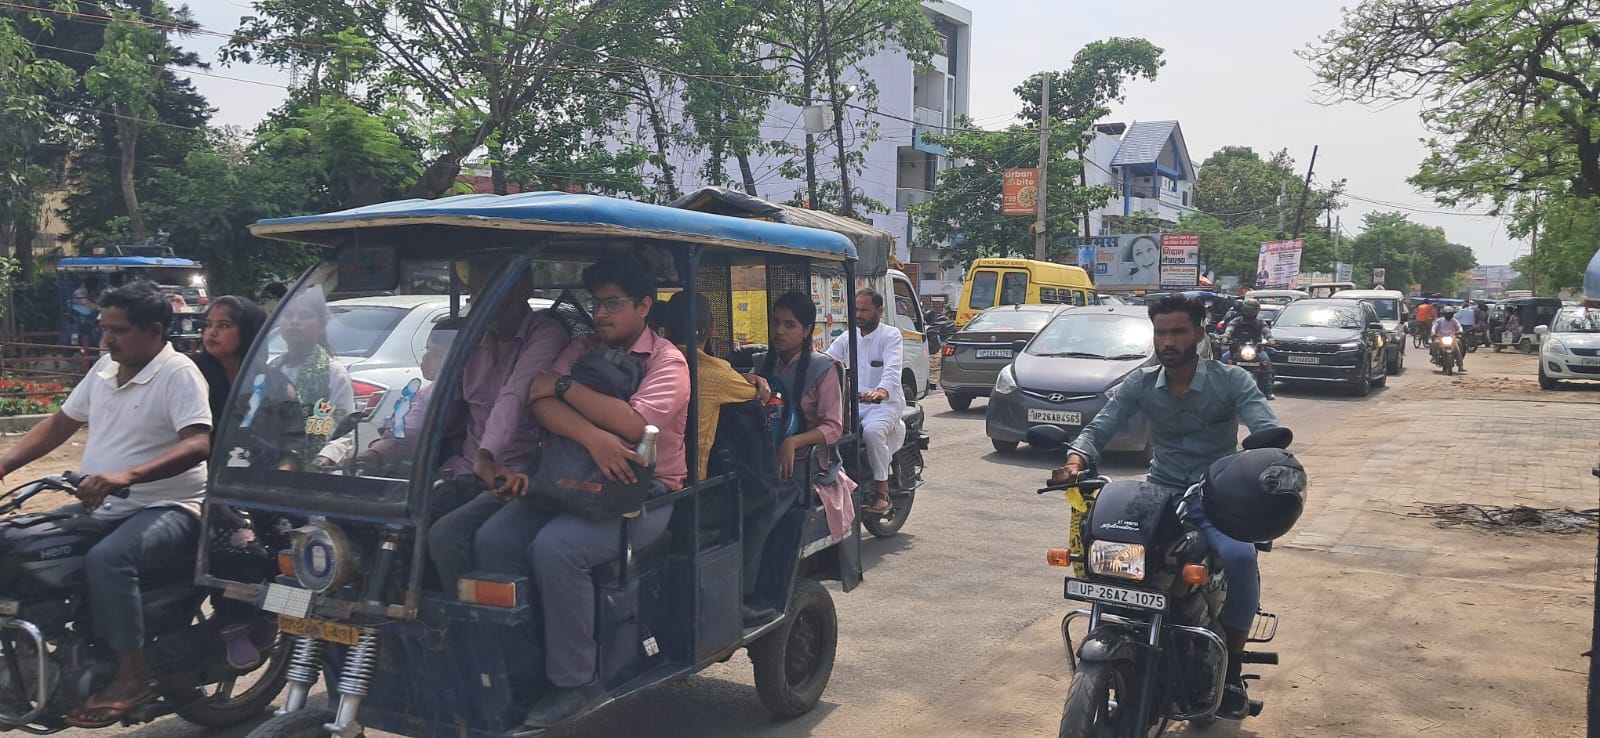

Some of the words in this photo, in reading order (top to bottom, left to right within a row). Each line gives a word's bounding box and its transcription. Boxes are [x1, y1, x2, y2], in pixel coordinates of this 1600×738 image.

[1005, 170, 1032, 178] urban
[1016, 178, 1034, 186] bite
[1032, 411, 1080, 423] UP26AB4565
[306, 416, 333, 435] 786
[40, 545, 72, 559] Hero
